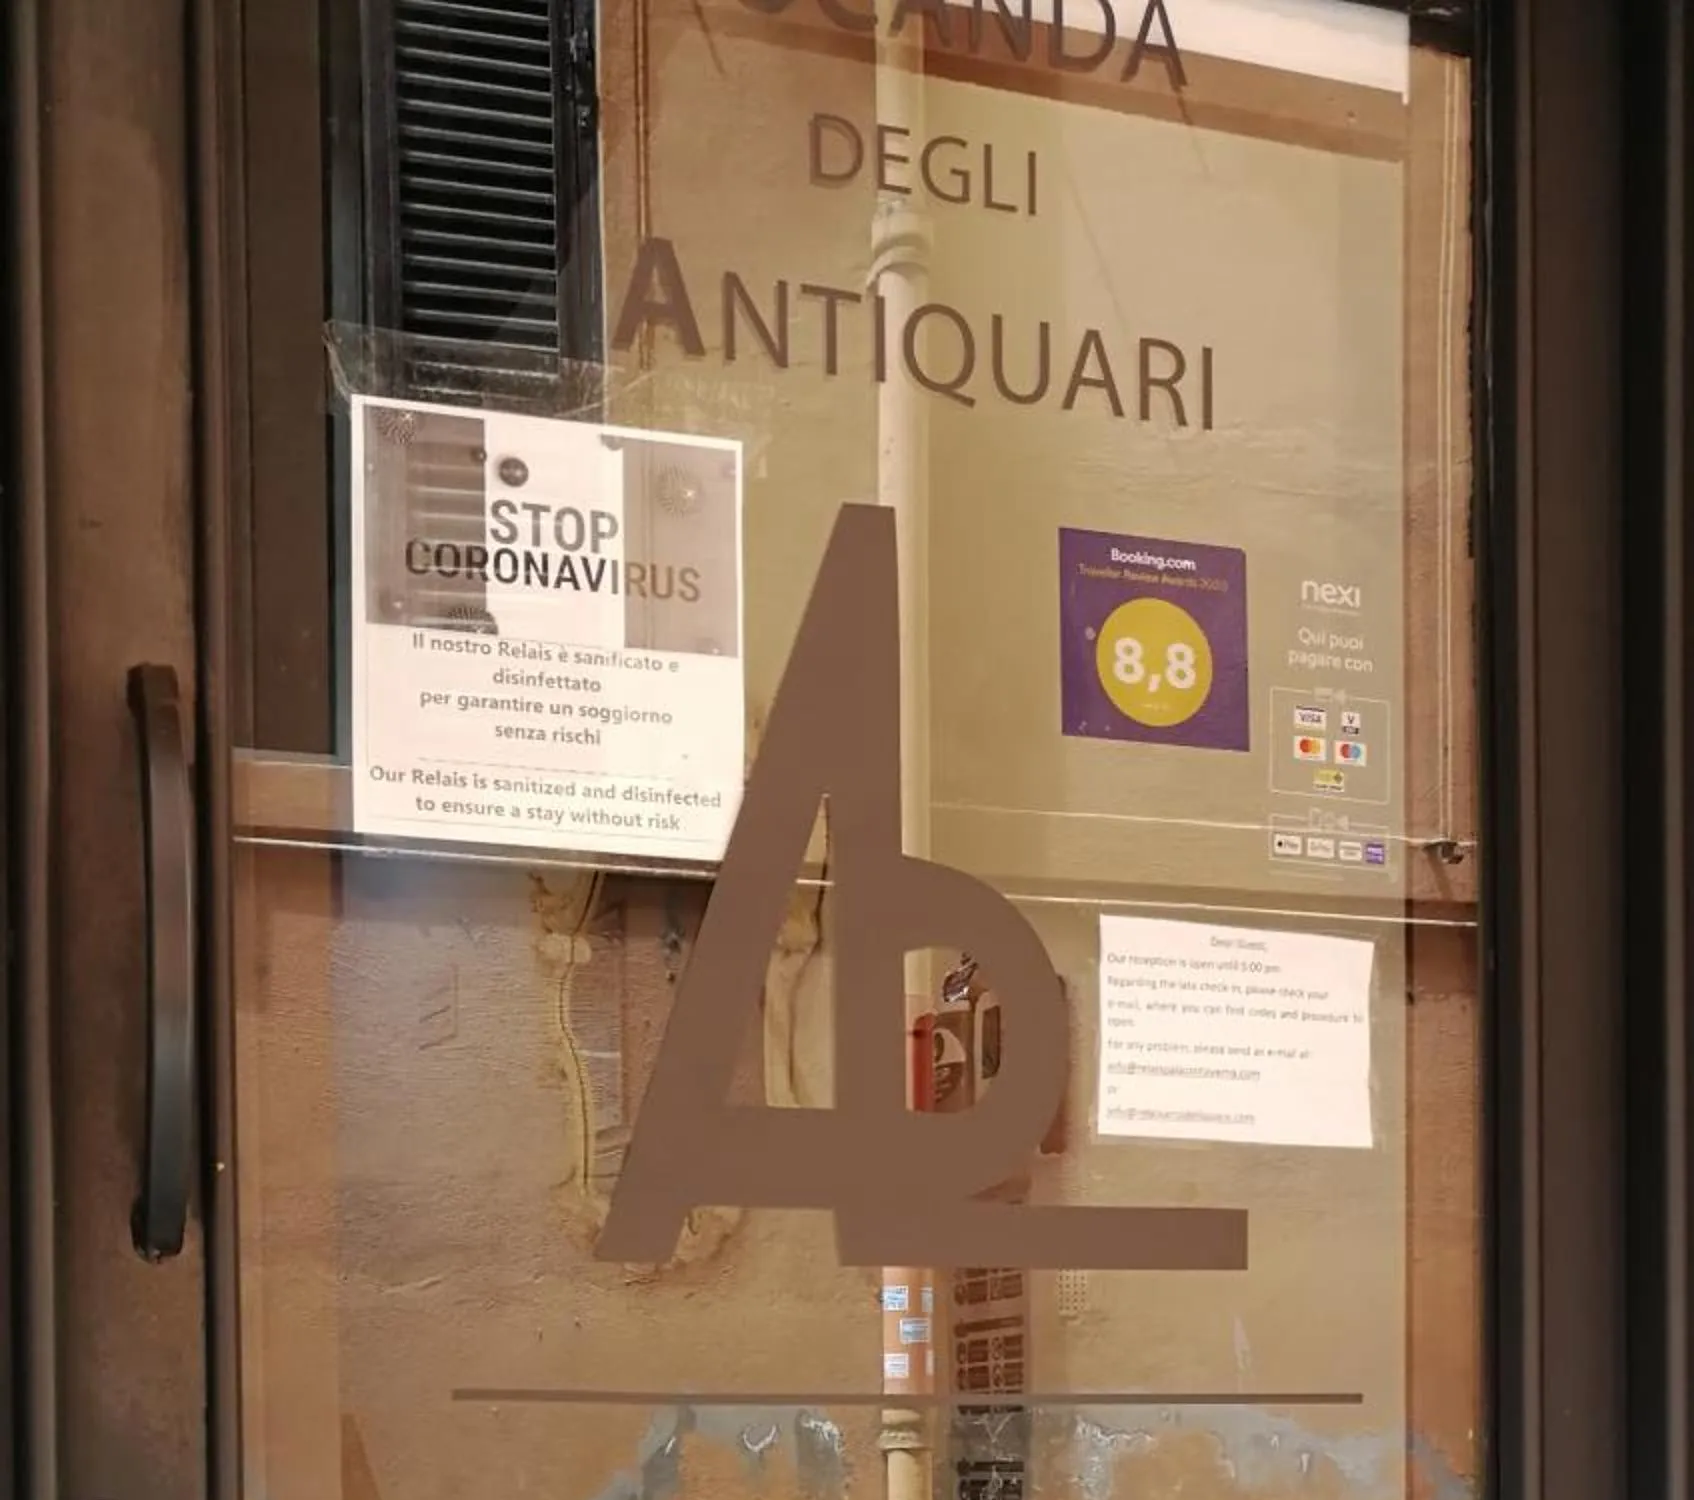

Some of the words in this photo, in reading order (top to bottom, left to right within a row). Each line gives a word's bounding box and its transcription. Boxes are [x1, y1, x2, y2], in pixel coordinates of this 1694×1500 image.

[742, 0, 1189, 88] ANDA
[808, 112, 1039, 217] DEGLI
[611, 236, 1215, 431] ANTIQUARI
[490, 499, 619, 554] STOP
[404, 537, 702, 603] CORONAVIRUS
[1110, 547, 1197, 571] Booking.com
[1301, 578, 1361, 609] nexi
[412, 632, 425, 650] Il
[430, 636, 492, 657] nostro
[498, 640, 552, 662] Relais
[573, 648, 664, 673] sanificato
[668, 659, 680, 674] e
[1297, 626, 1327, 647] Qui
[1328, 630, 1364, 652] puoi
[1113, 636, 1197, 692] 8,8
[1288, 648, 1342, 673] pagare
[1344, 655, 1374, 673] con
[492, 668, 602, 694] disinfettato
[419, 689, 451, 711] per
[457, 691, 544, 715] garantire
[549, 701, 574, 718] un
[578, 703, 673, 726] soggiorno
[494, 725, 547, 742] senza
[552, 725, 602, 746] rischi
[369, 765, 407, 784] Our
[411, 768, 468, 790] Relais
[472, 773, 488, 791] is
[492, 774, 577, 798] sanitized
[581, 780, 617, 801] and
[621, 784, 722, 809] disinfected
[415, 795, 436, 812] to
[441, 799, 506, 819] ensure
[510, 804, 522, 819] a
[526, 805, 566, 827] stay
[570, 806, 643, 829] without
[647, 811, 681, 832] risk
